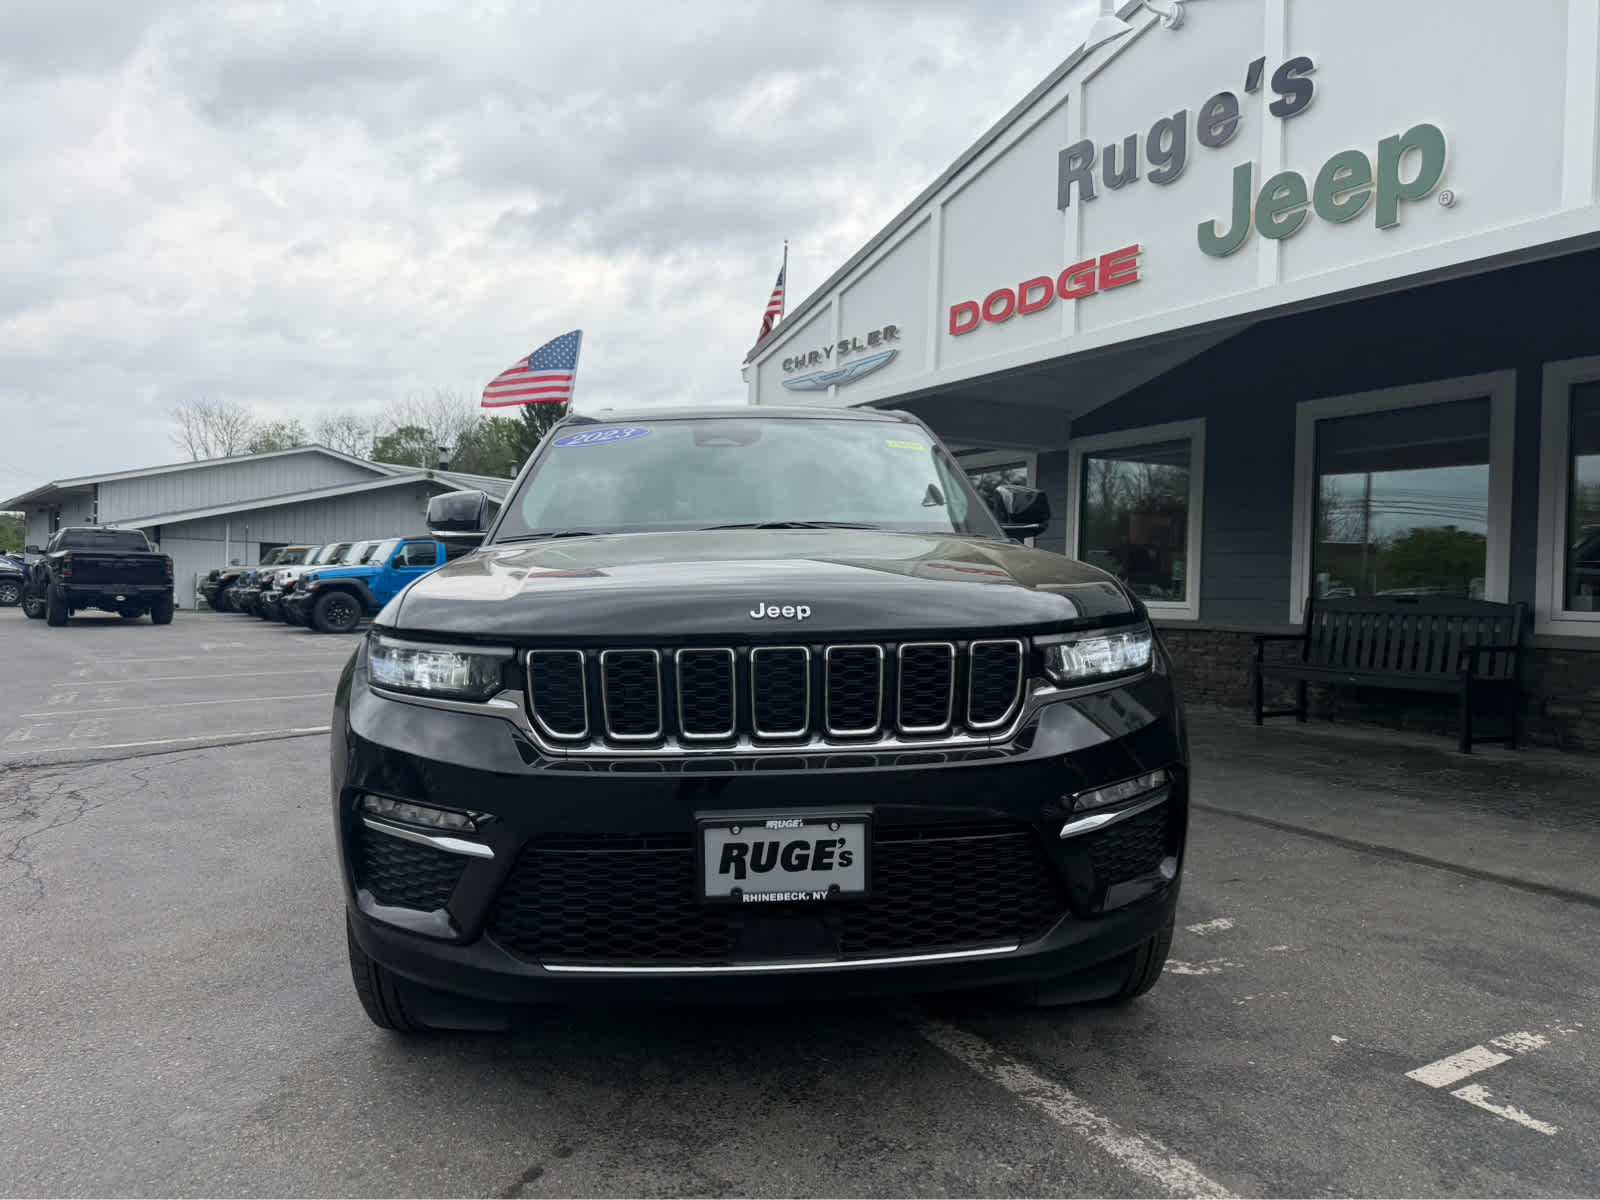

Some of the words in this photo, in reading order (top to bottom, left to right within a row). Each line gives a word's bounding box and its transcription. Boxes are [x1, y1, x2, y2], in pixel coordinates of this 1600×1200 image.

[1057, 56, 1318, 212] Ruge's
[1197, 123, 1448, 258] Jeep
[949, 243, 1142, 337] DODGE
[782, 325, 900, 372] CHRYSLER
[567, 428, 635, 445] 2023
[750, 602, 811, 620] Jeep
[718, 837, 854, 880] RUGE's
[812, 890, 829, 900] NY
